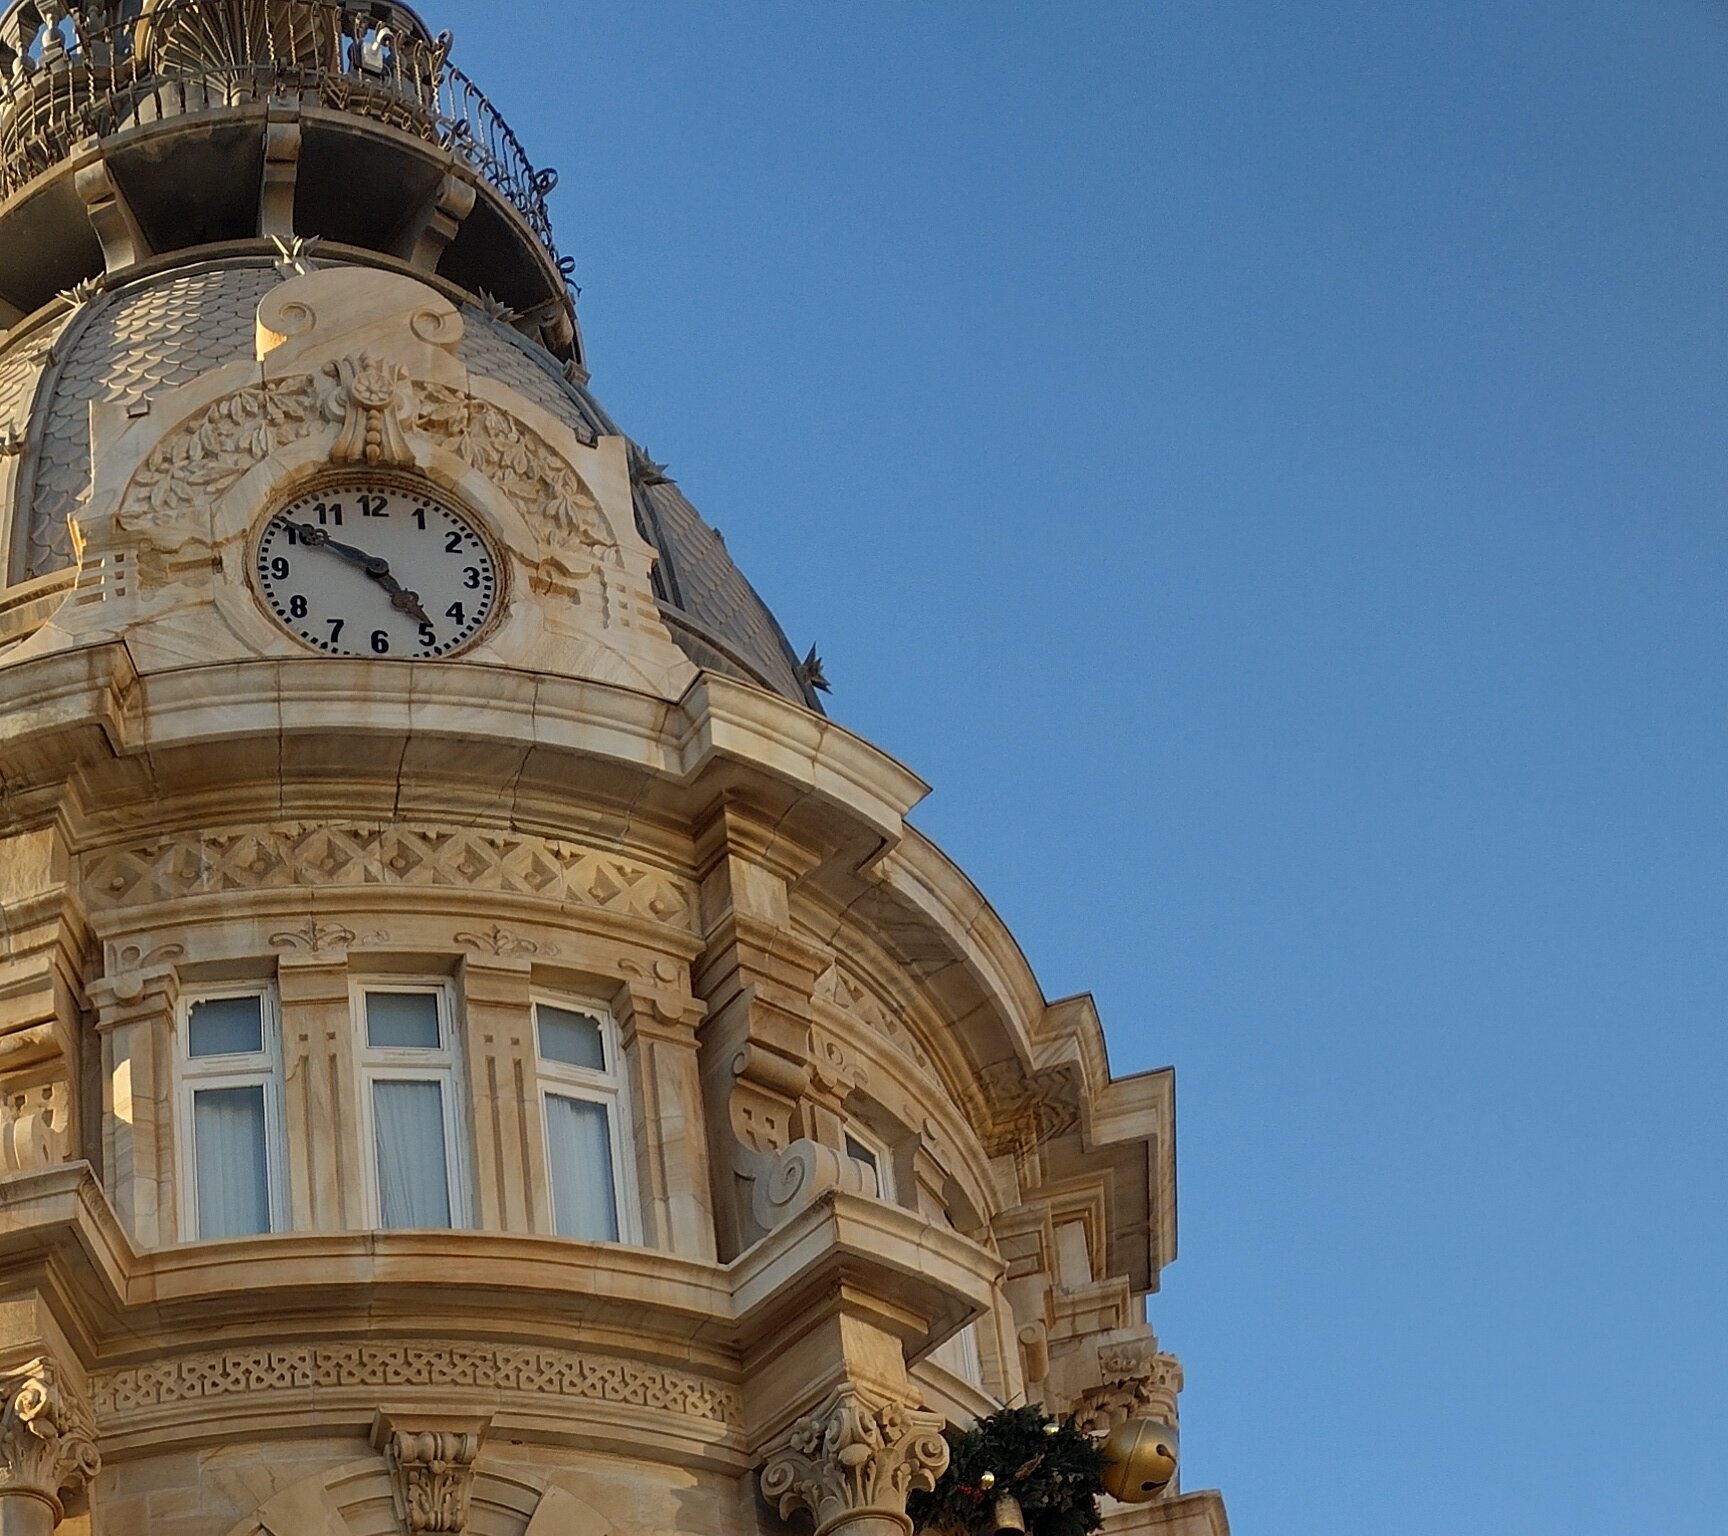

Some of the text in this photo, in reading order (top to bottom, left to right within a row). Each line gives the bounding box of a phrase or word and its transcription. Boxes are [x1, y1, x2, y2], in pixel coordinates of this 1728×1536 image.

[313, 503, 343, 525] 11
[356, 495, 390, 517] 12
[411, 508, 426, 530] 1
[445, 531, 463, 553] 2
[271, 557, 289, 580] 9
[463, 566, 480, 589] 3
[290, 595, 308, 618] 8
[445, 602, 465, 625] 4
[326, 619, 344, 643] 7
[370, 630, 389, 654] 6
[419, 623, 436, 647] 5
